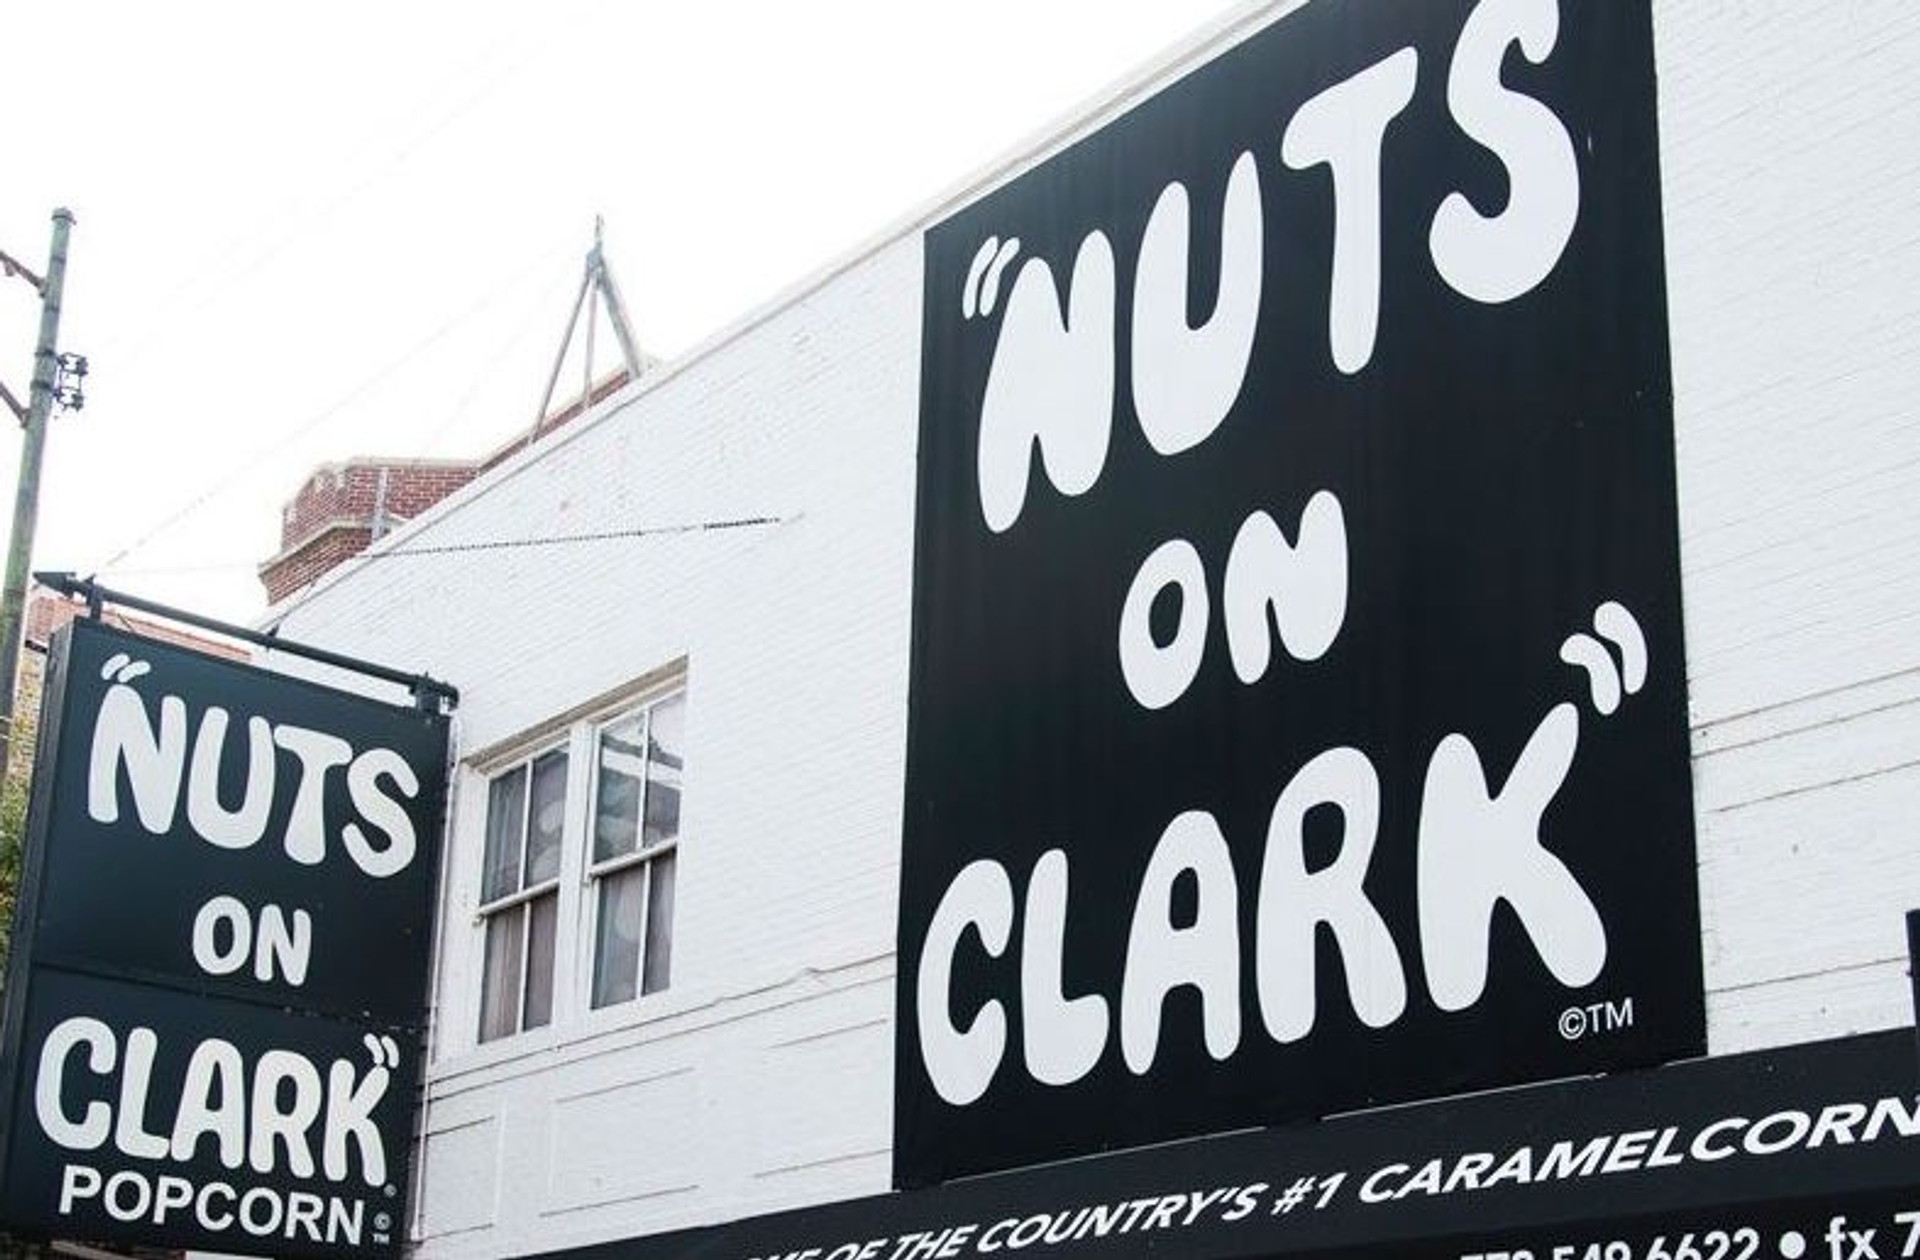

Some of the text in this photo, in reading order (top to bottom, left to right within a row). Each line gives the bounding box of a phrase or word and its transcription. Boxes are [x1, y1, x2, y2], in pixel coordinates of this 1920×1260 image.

[1118, 490, 1348, 710] ON
[192, 895, 312, 986] ON
[59, 1164, 365, 1245] POPCORN
[888, 1223, 979, 1260] THE
[976, 1182, 1269, 1253] COUNTRY'S
[1271, 1172, 1347, 1215] #1
[1824, 1215, 1880, 1260] fx
